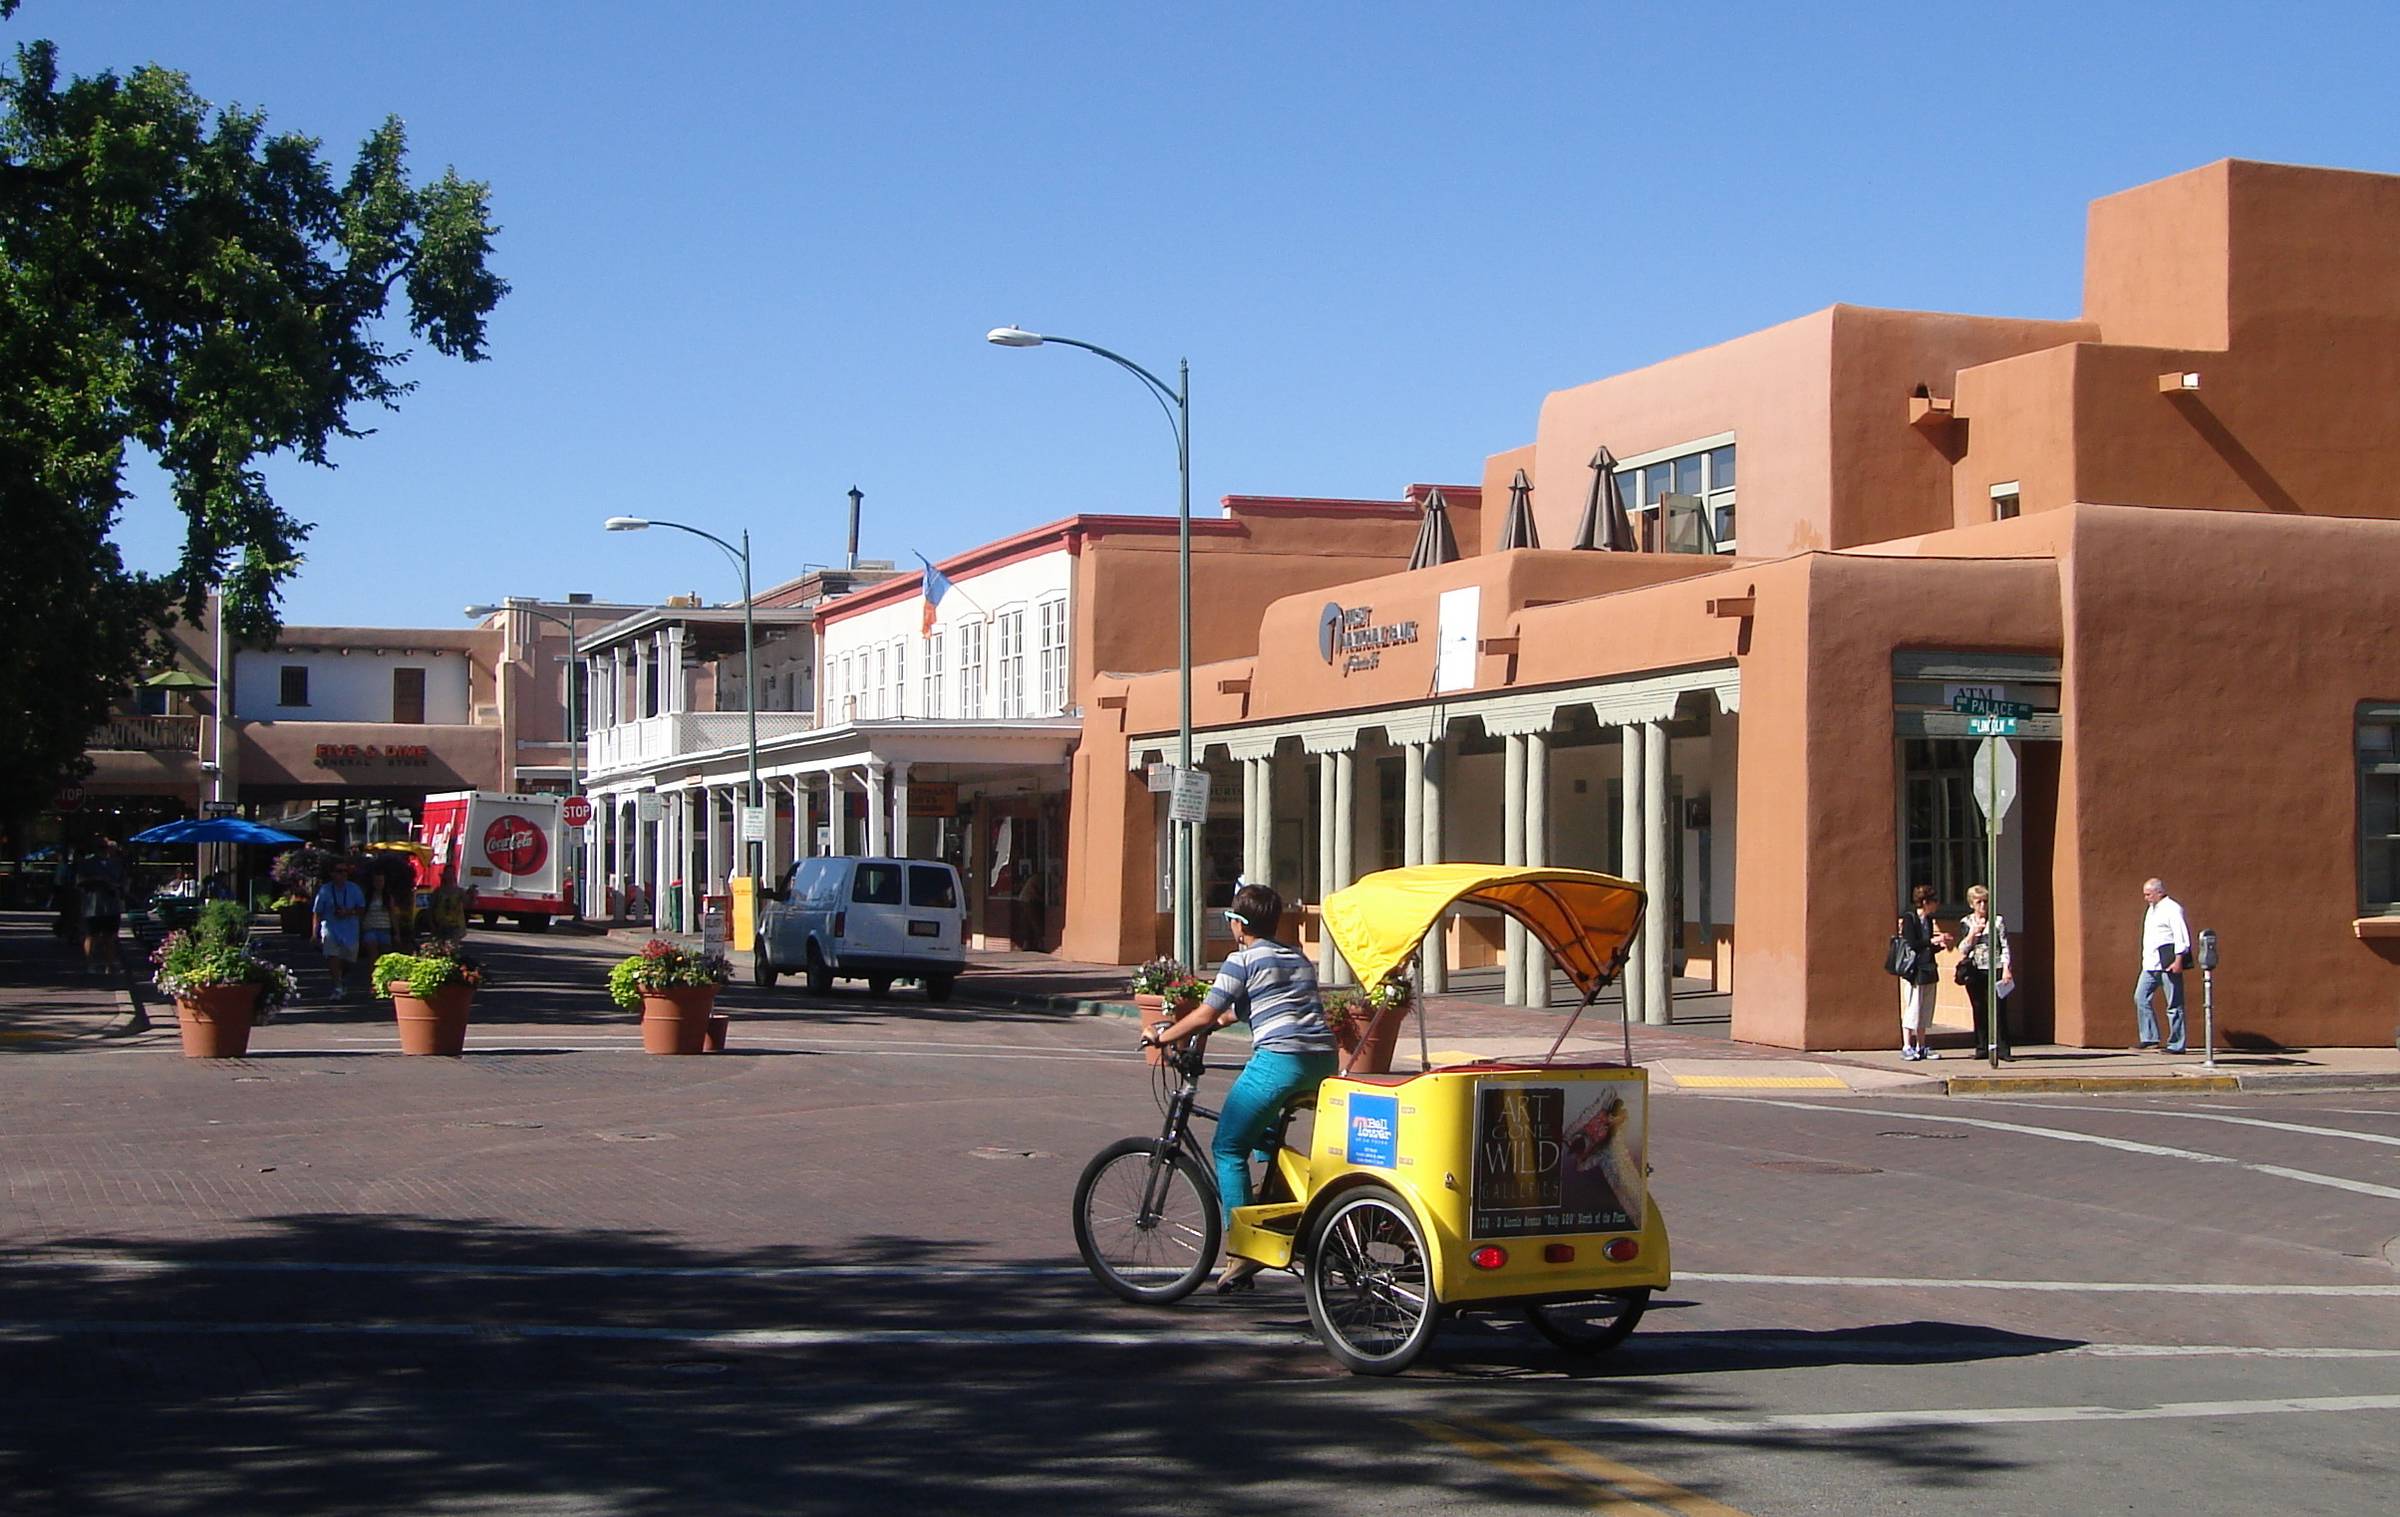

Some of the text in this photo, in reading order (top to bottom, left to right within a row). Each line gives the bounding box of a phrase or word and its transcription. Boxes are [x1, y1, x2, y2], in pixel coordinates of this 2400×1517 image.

[1957, 687, 1993, 701] ATM
[1971, 700, 2014, 716] PALACE
[315, 743, 429, 758] FIVE & DIME
[564, 805, 590, 818] STOP
[1498, 1094, 1551, 1122] ART
[1491, 1122, 1554, 1140] GONE
[1485, 1140, 1561, 1174] WILD
